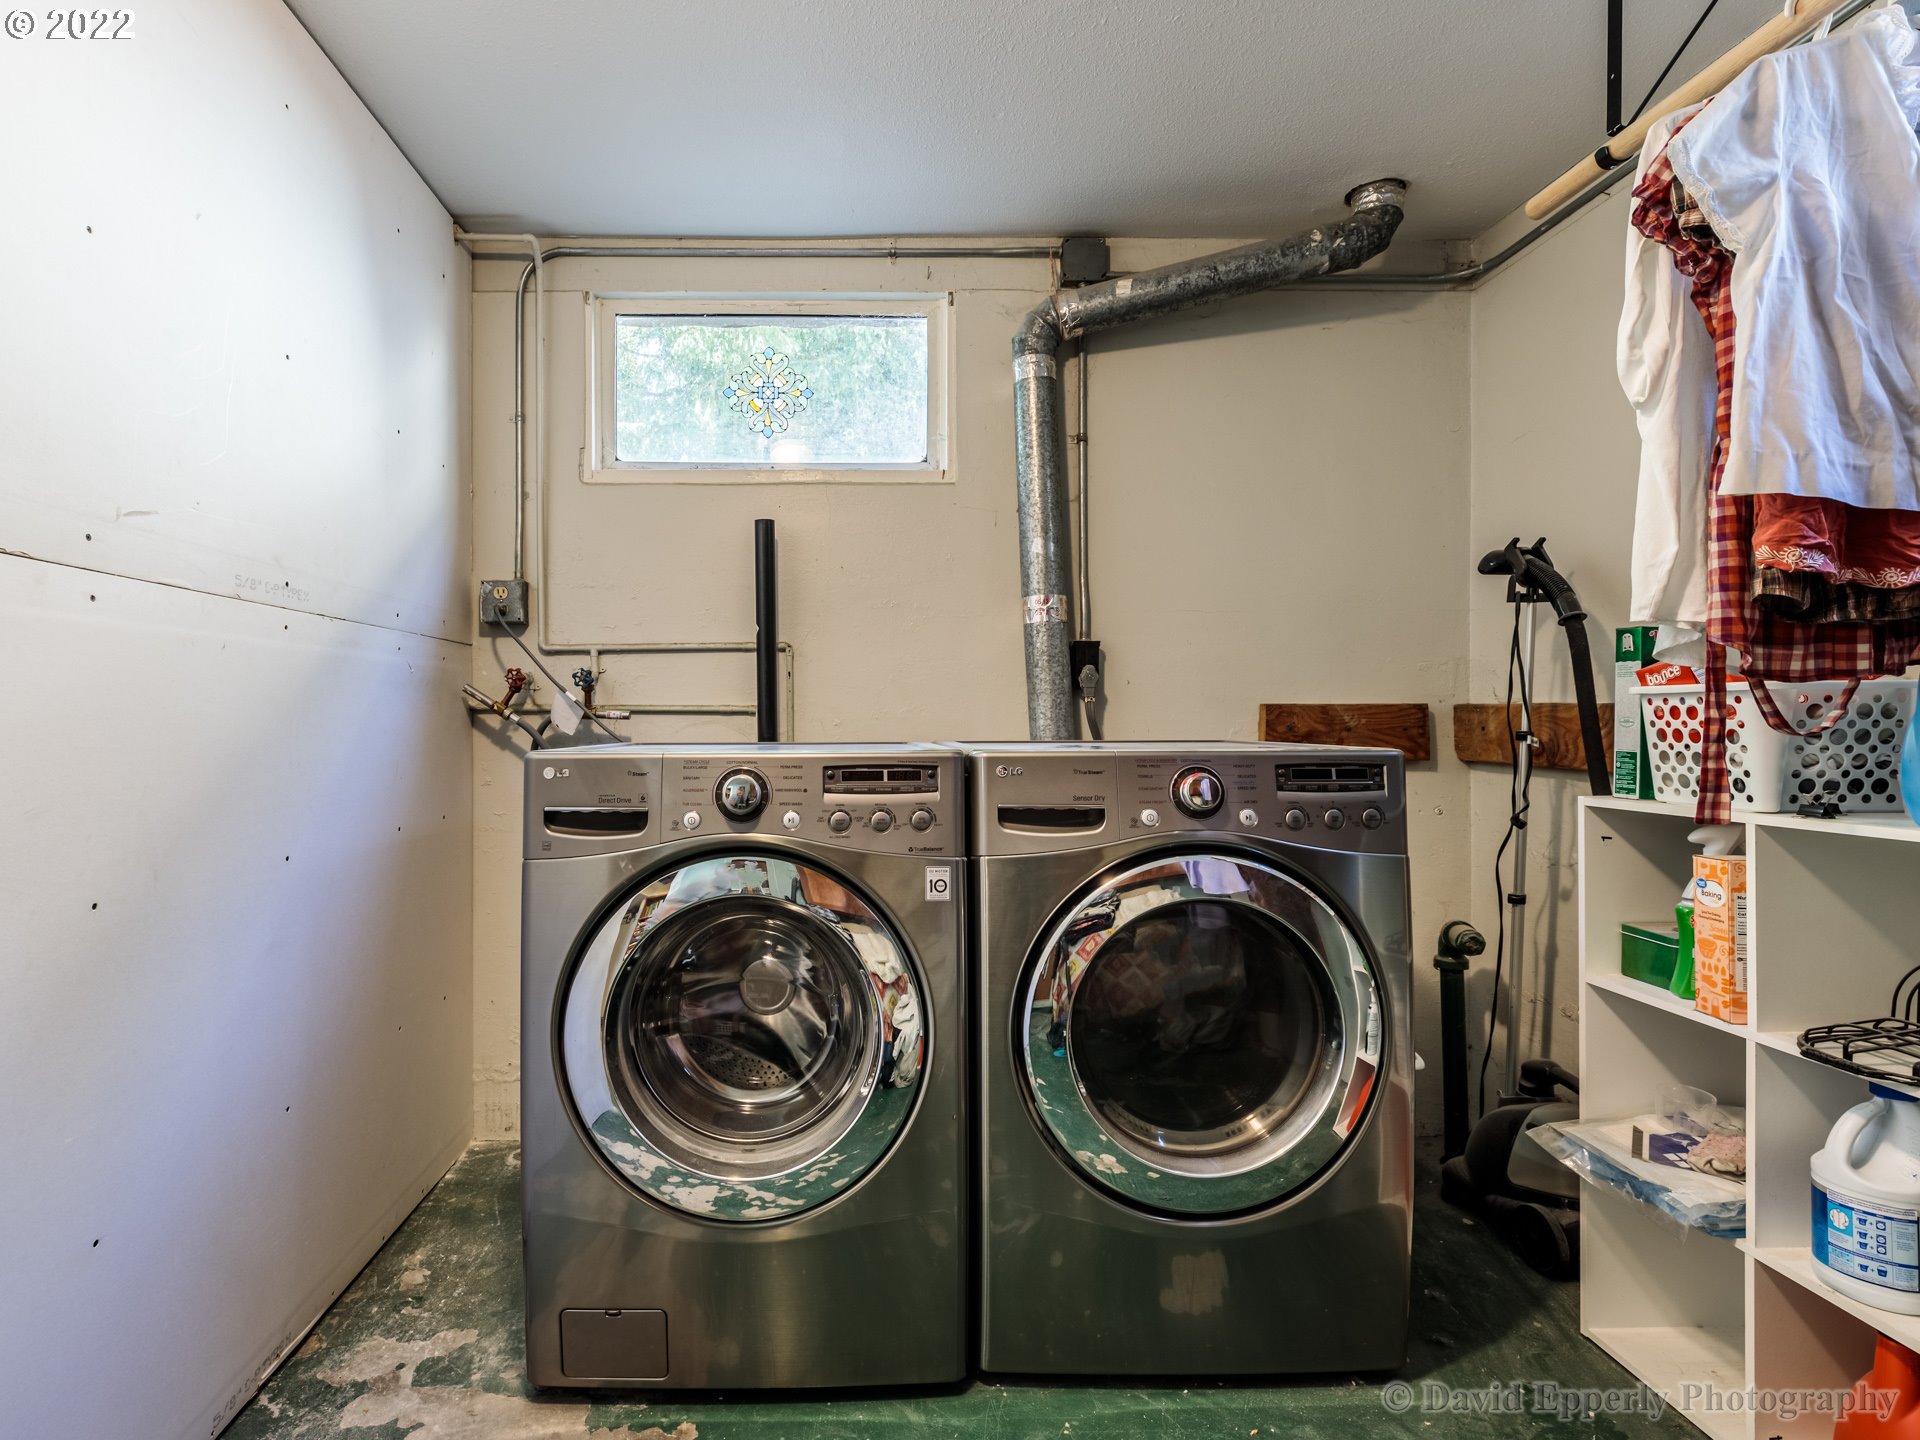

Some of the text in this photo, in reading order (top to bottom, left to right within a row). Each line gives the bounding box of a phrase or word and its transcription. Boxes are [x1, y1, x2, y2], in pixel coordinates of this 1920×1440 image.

[1645, 665, 1682, 686] bounce
[929, 878, 948, 894] 10
[1701, 889, 1722, 901] Baking
